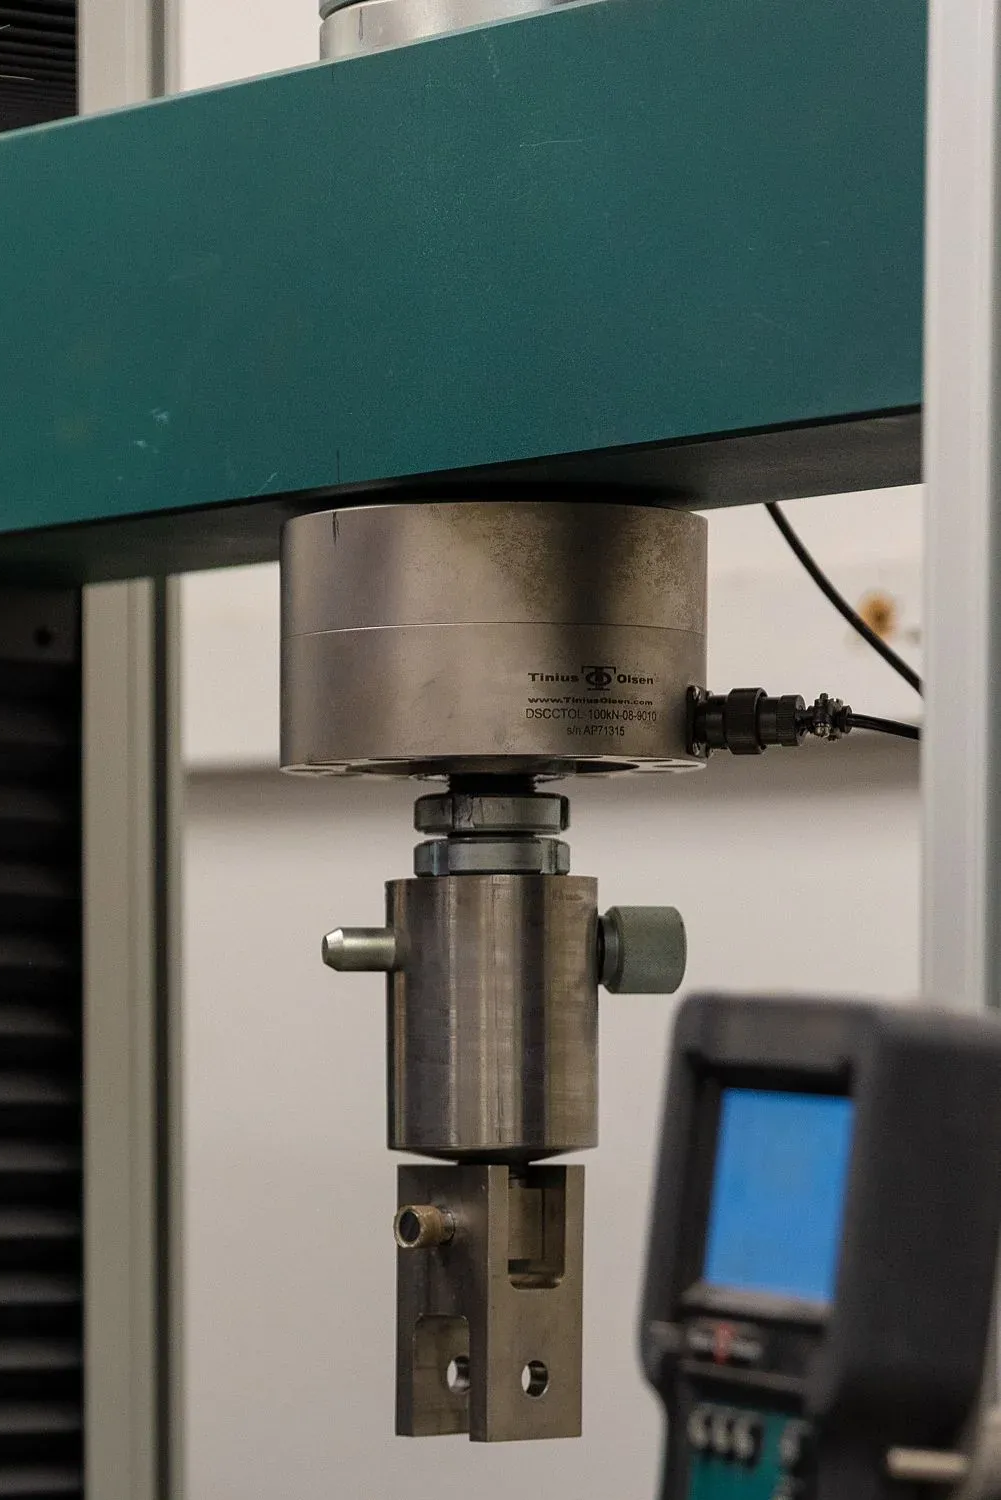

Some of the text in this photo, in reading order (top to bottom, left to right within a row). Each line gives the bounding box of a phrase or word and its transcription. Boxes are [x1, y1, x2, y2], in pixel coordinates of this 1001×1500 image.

[527, 672, 654, 685] Tinius Olsen
[527, 696, 653, 705] www.TiniusOlsen.com
[566, 725, 625, 737] s/n AP71315
